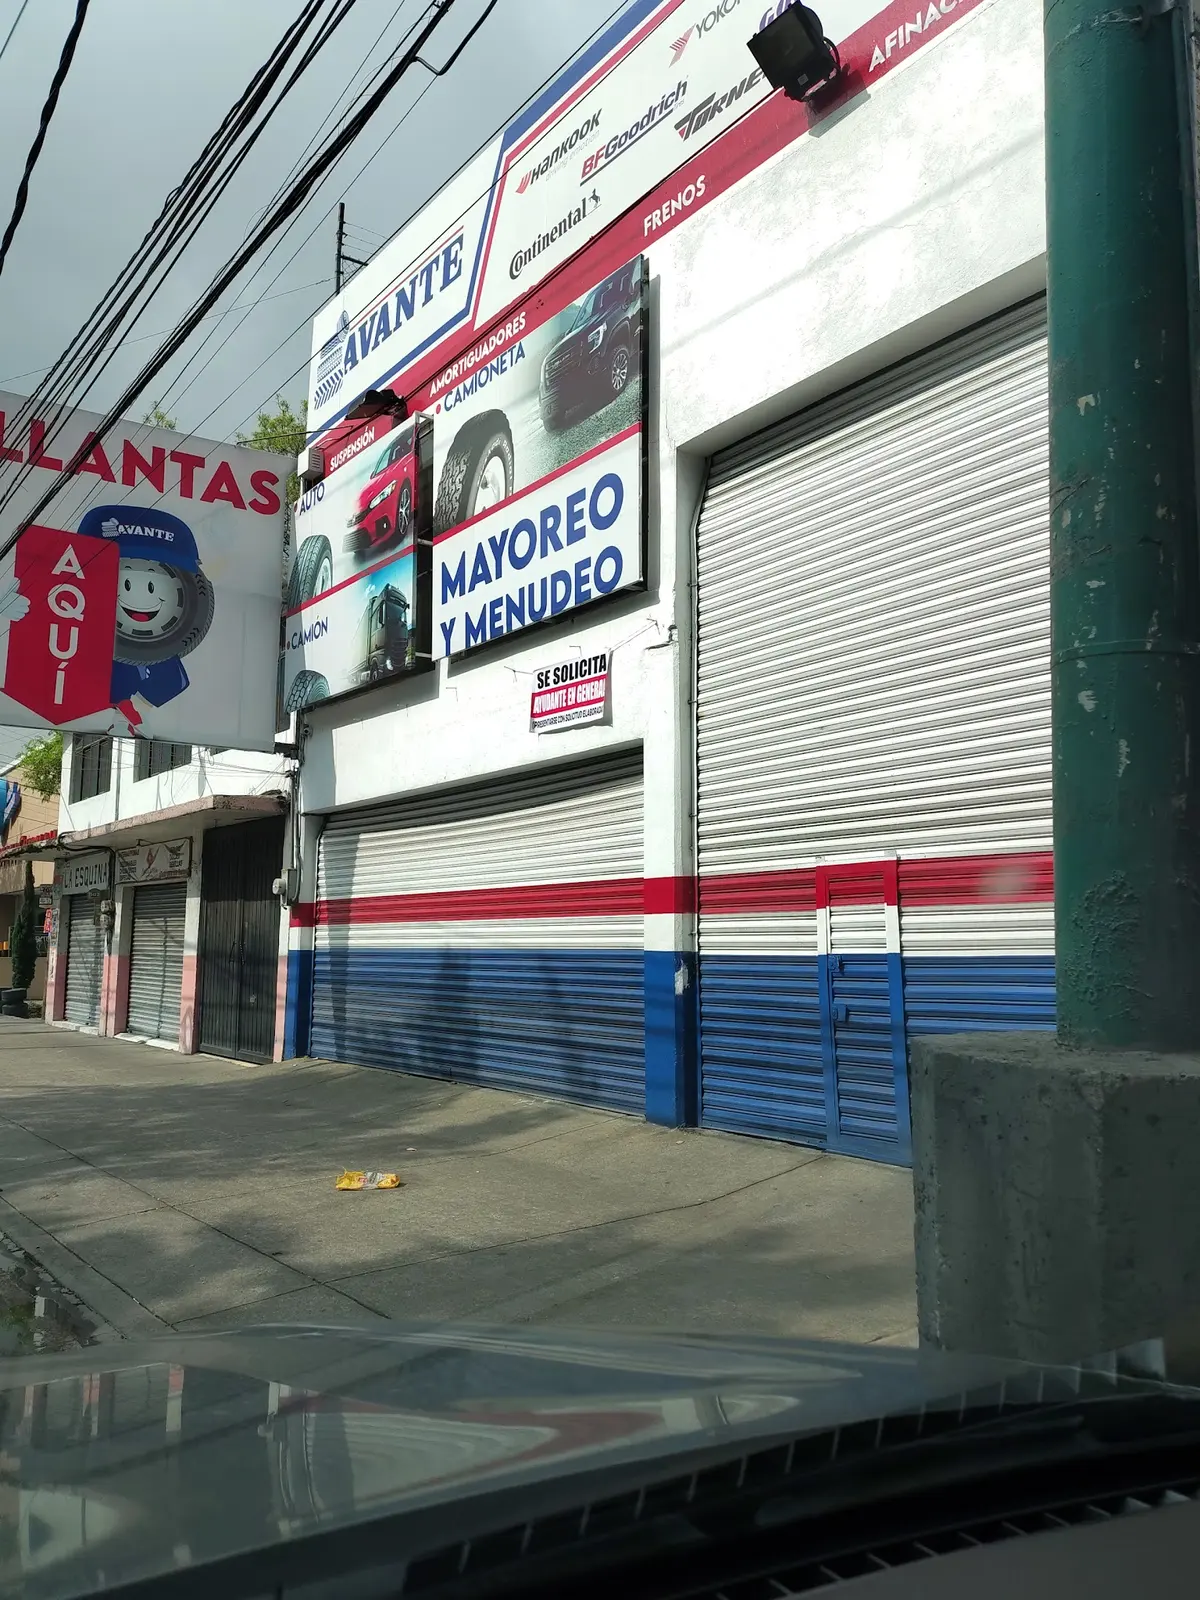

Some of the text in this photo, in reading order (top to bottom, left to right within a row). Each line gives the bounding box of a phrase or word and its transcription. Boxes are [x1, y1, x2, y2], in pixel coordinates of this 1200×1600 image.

[696, 0, 741, 39] YOKO
[581, 80, 688, 180] BFGoodrich
[673, 67, 766, 141] TORNE
[509, 197, 587, 281] Continental
[643, 175, 706, 237] FRENOS
[343, 233, 464, 376] AVANTE
[429, 312, 527, 398] AMORTIGUADORES
[444, 342, 527, 412] CAMIONETA
[0, 410, 281, 516] LLANTAS
[330, 426, 376, 473] SUSPENSIÓN
[299, 482, 326, 516] AUTO
[116, 524, 175, 542] AVANTE
[441, 472, 624, 605] MAYOREO
[291, 615, 328, 651] CAMIÓN
[440, 545, 623, 656] Y MENUDEO
[533, 689, 567, 714] AYUDANTE
[567, 686, 577, 706] EN
[537, 653, 607, 689] SE SOLICITA
[64, 869, 73, 889] LA
[75, 861, 108, 888] ESQUINA
